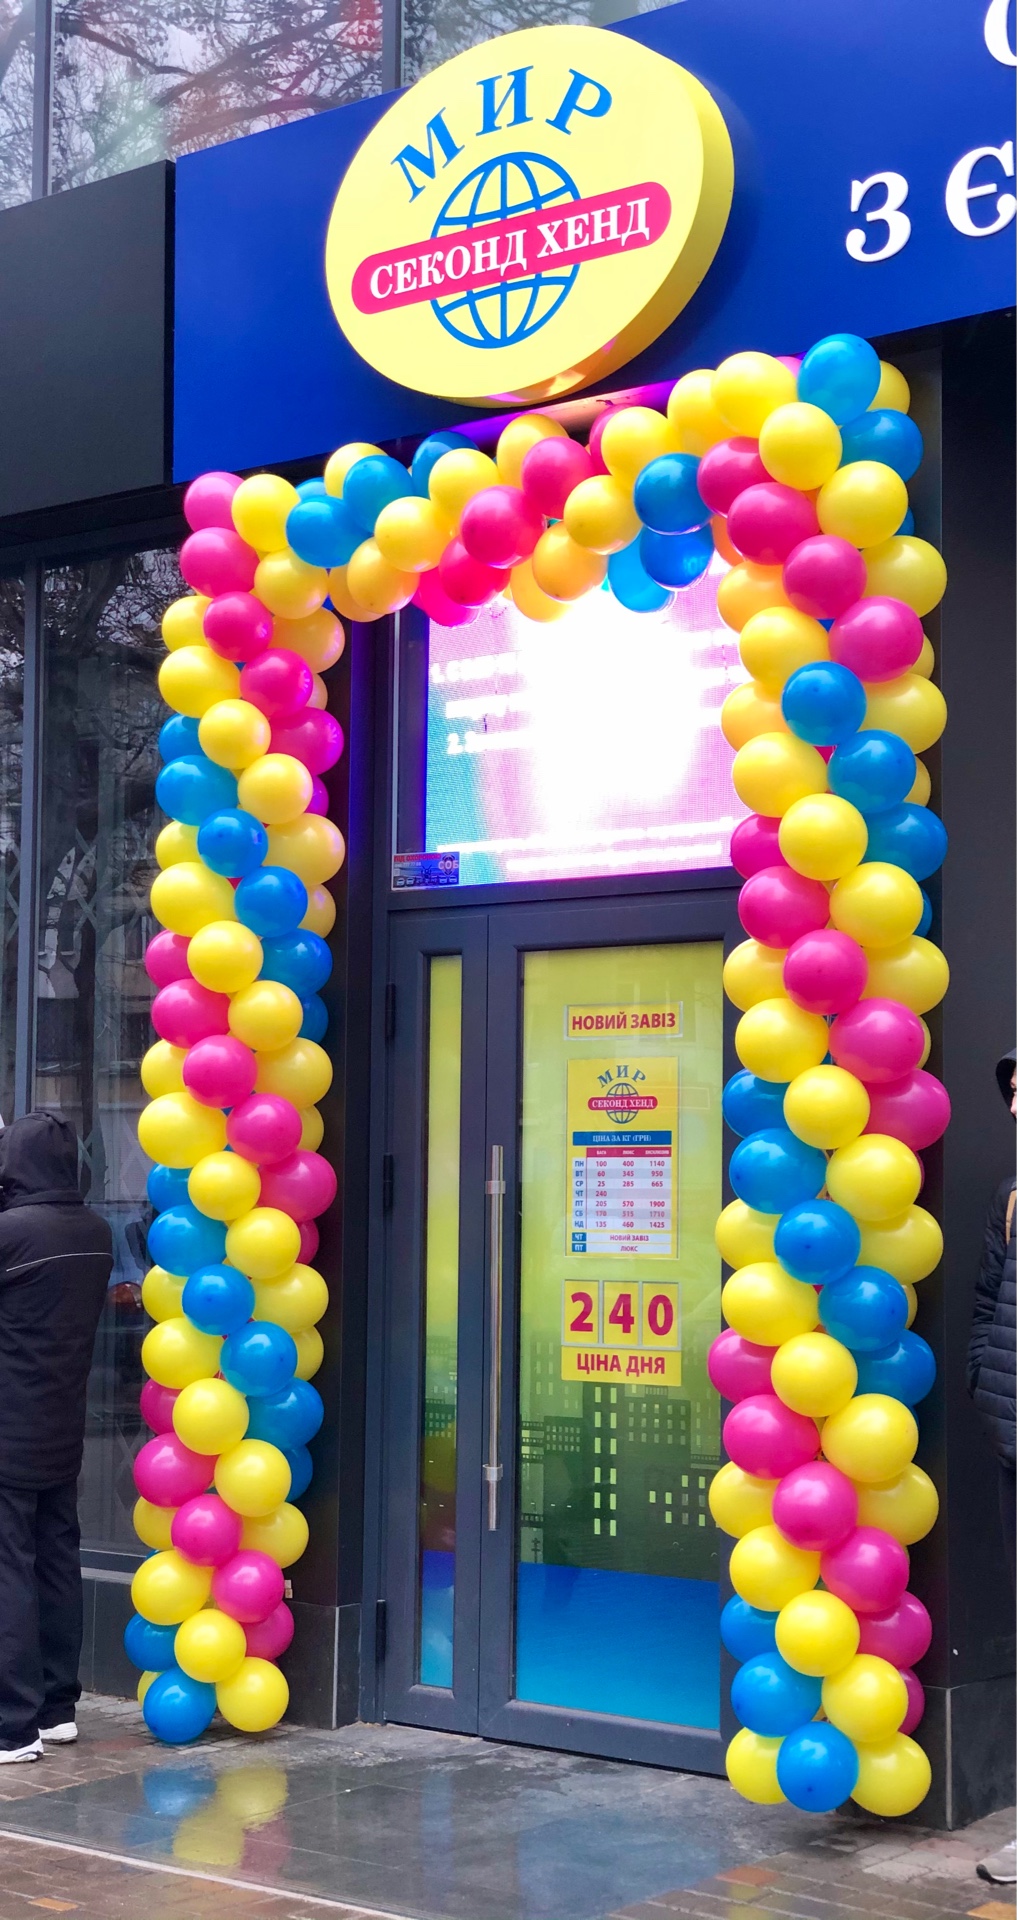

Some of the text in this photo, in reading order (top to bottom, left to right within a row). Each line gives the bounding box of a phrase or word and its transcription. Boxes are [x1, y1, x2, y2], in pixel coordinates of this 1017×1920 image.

[391, 65, 612, 203] МИР
[369, 197, 650, 300] СЕКОНД ХЕНД
[438, 860, 459, 870] СОБ
[572, 1011, 676, 1030] НОВИЙ ЗАВІЗ
[597, 1064, 646, 1089] МИР
[592, 1098, 654, 1108] СЕКОНД ХЕНД
[632, 1134, 652, 1142] (ГРН)
[570, 1291, 674, 1336] 240
[577, 1353, 665, 1377] ЦІНА ДНЯ
